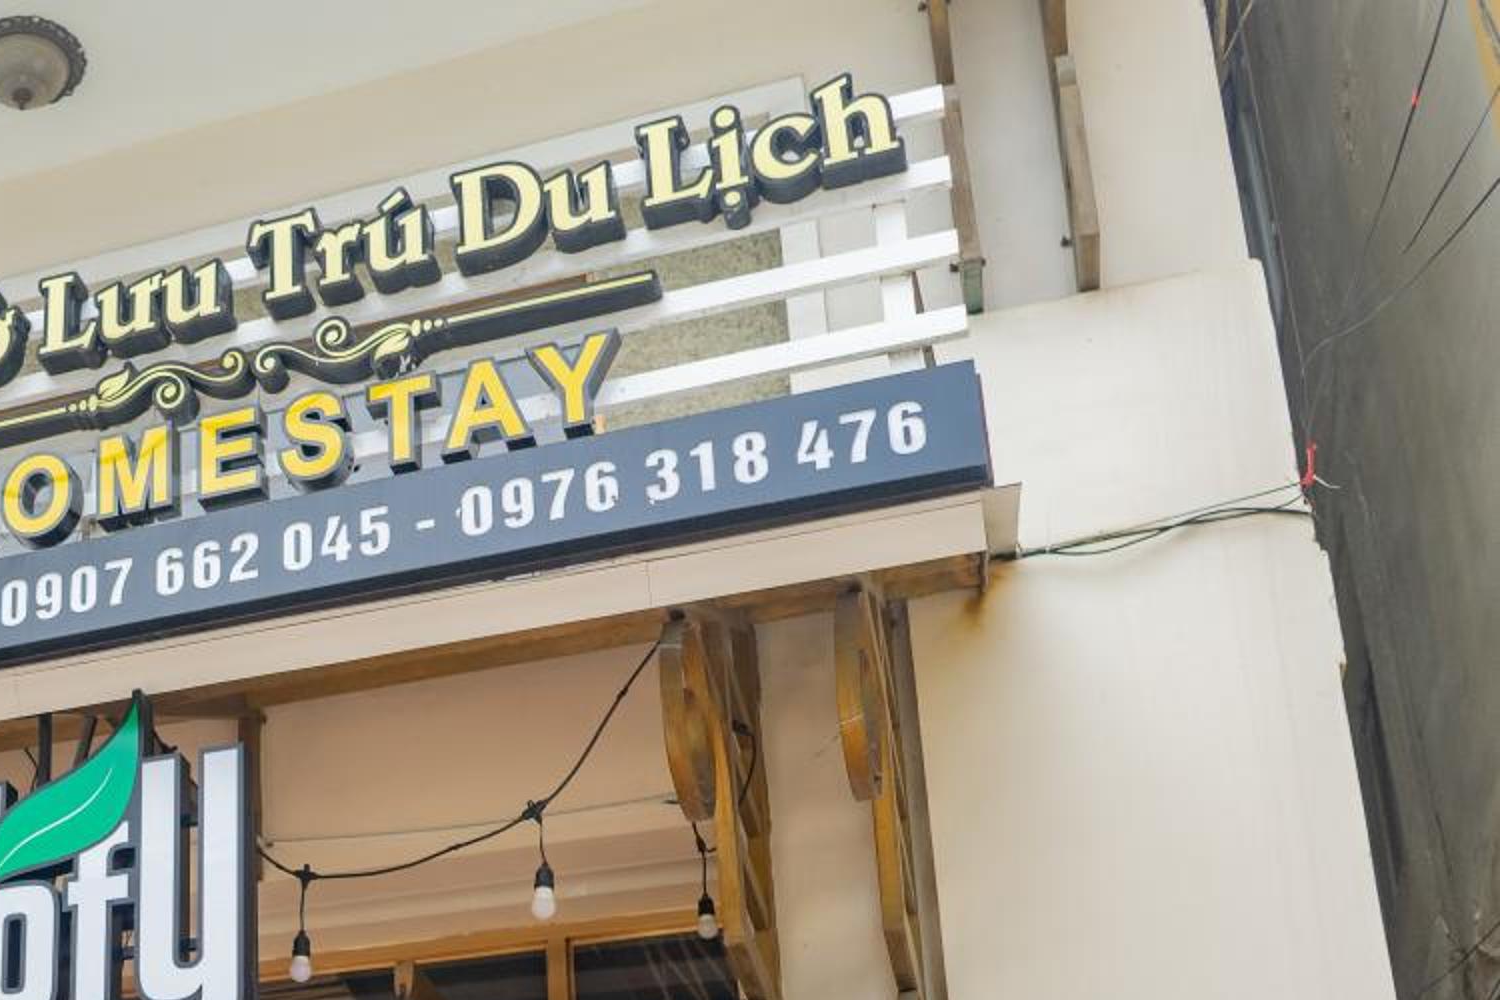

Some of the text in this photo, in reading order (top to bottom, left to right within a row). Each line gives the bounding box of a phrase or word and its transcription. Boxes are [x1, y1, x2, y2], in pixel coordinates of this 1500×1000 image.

[41, 256, 230, 364] Lưu
[250, 190, 438, 316] Trú
[453, 155, 622, 272] Du
[637, 74, 902, 230] Lịch
[2, 401, 927, 628] 0907 662 045 0976 318 476
